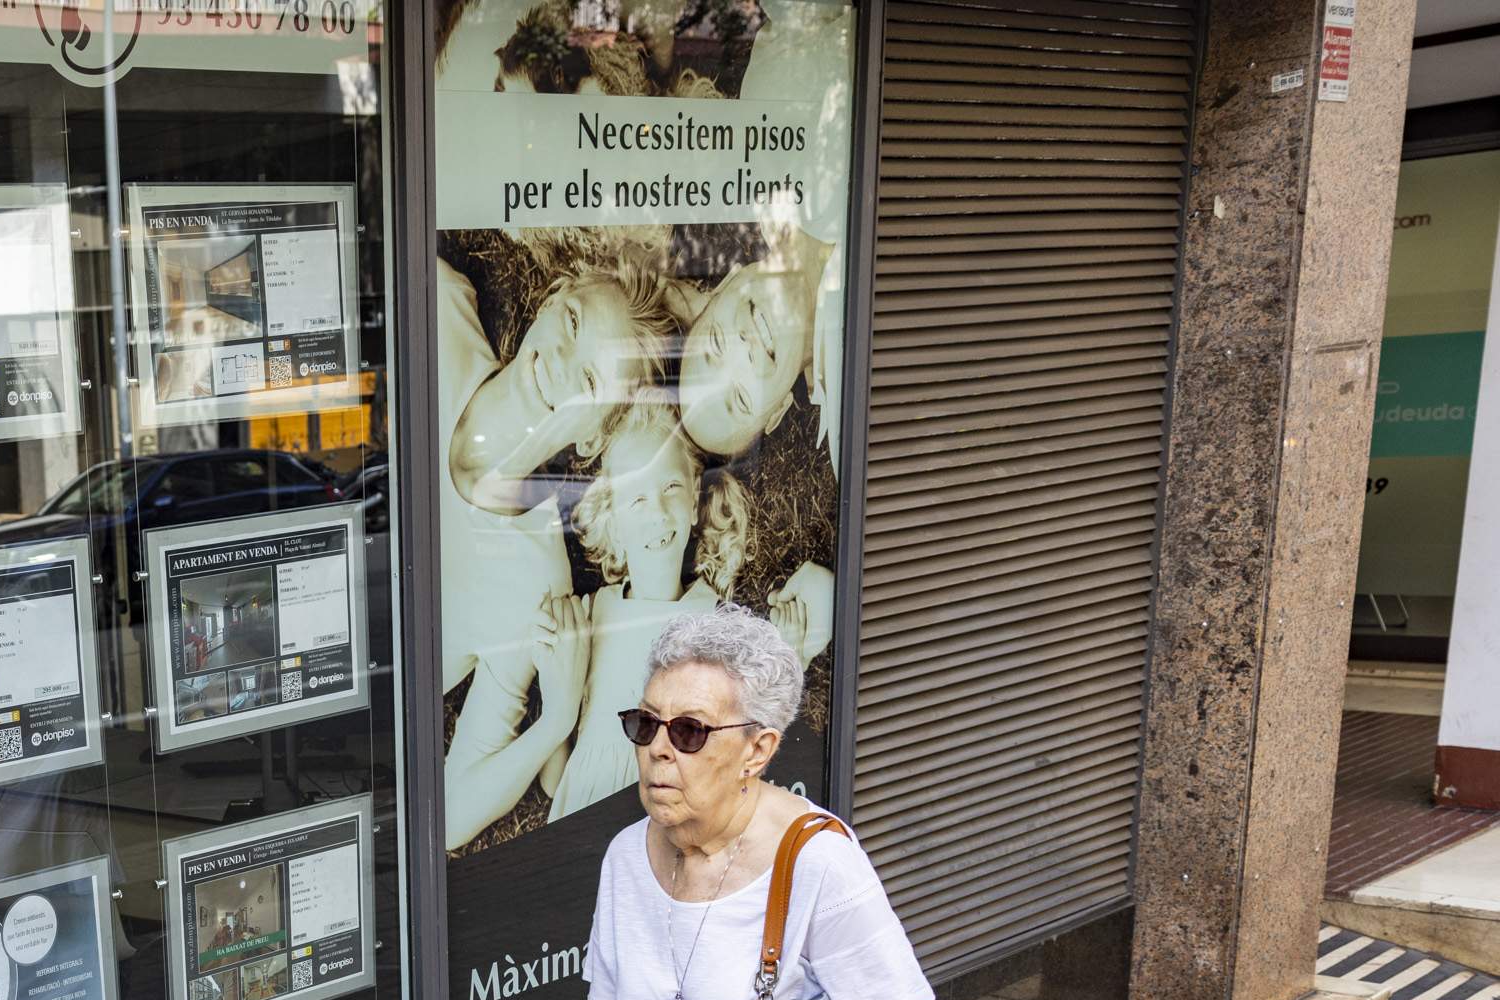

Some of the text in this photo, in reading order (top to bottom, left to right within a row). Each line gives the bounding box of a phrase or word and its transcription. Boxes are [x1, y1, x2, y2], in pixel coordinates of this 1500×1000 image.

[157, 0, 355, 33] 93 430 78 00
[1328, 5, 1355, 17] verisure
[578, 111, 806, 163] Necessitem pisos
[504, 168, 804, 223] per els nostres clients
[149, 217, 166, 229] PIS
[166, 216, 180, 228] EN
[181, 215, 213, 227] VENDA
[309, 362, 337, 373] donpiso
[19, 391, 53, 403] donpiso
[173, 552, 234, 570] APARTAMENT
[235, 550, 248, 560] EN
[249, 545, 279, 558] VENDA
[318, 672, 344, 686] donpiso
[42, 727, 75, 743] donpiso
[188, 865, 202, 876] PIS
[203, 862, 216, 872] EN
[217, 853, 247, 868] VENDA
[216, 936, 269, 956] HA BAIXAT DE PREU
[328, 957, 354, 971] donpiso
